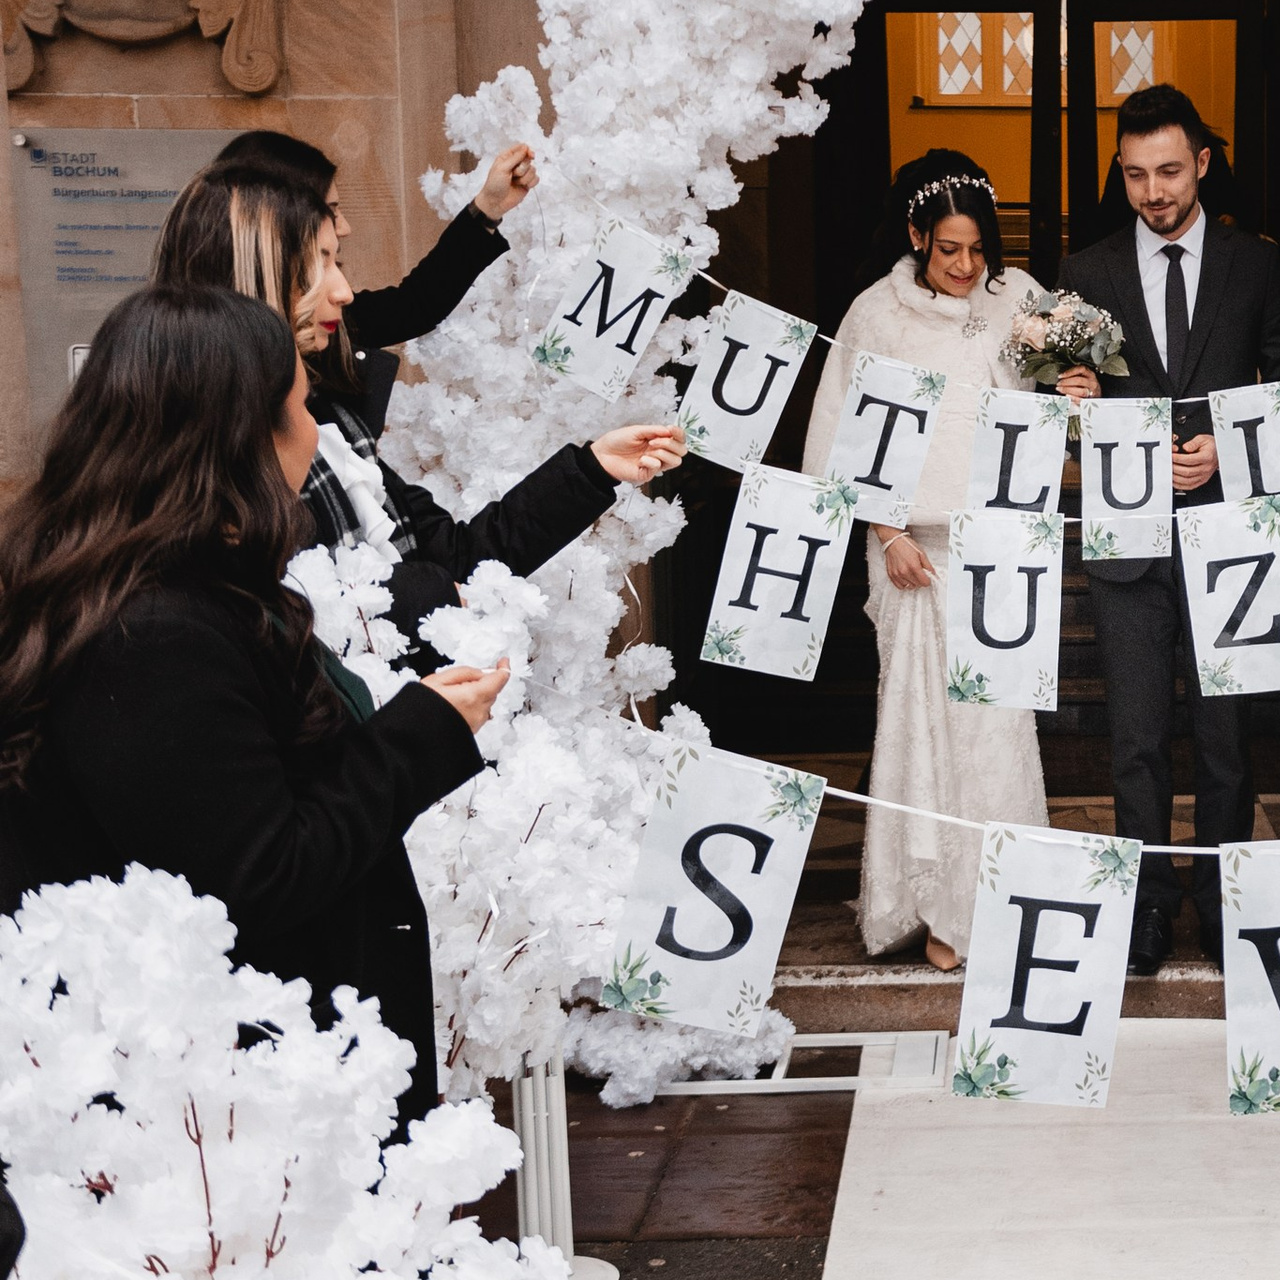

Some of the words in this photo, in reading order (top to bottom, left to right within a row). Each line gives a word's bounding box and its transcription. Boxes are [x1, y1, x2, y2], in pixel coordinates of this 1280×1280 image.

[51, 152, 97, 164] STADT
[53, 166, 119, 177] BOCHUM
[53, 187, 118, 199] Bürgerbüro
